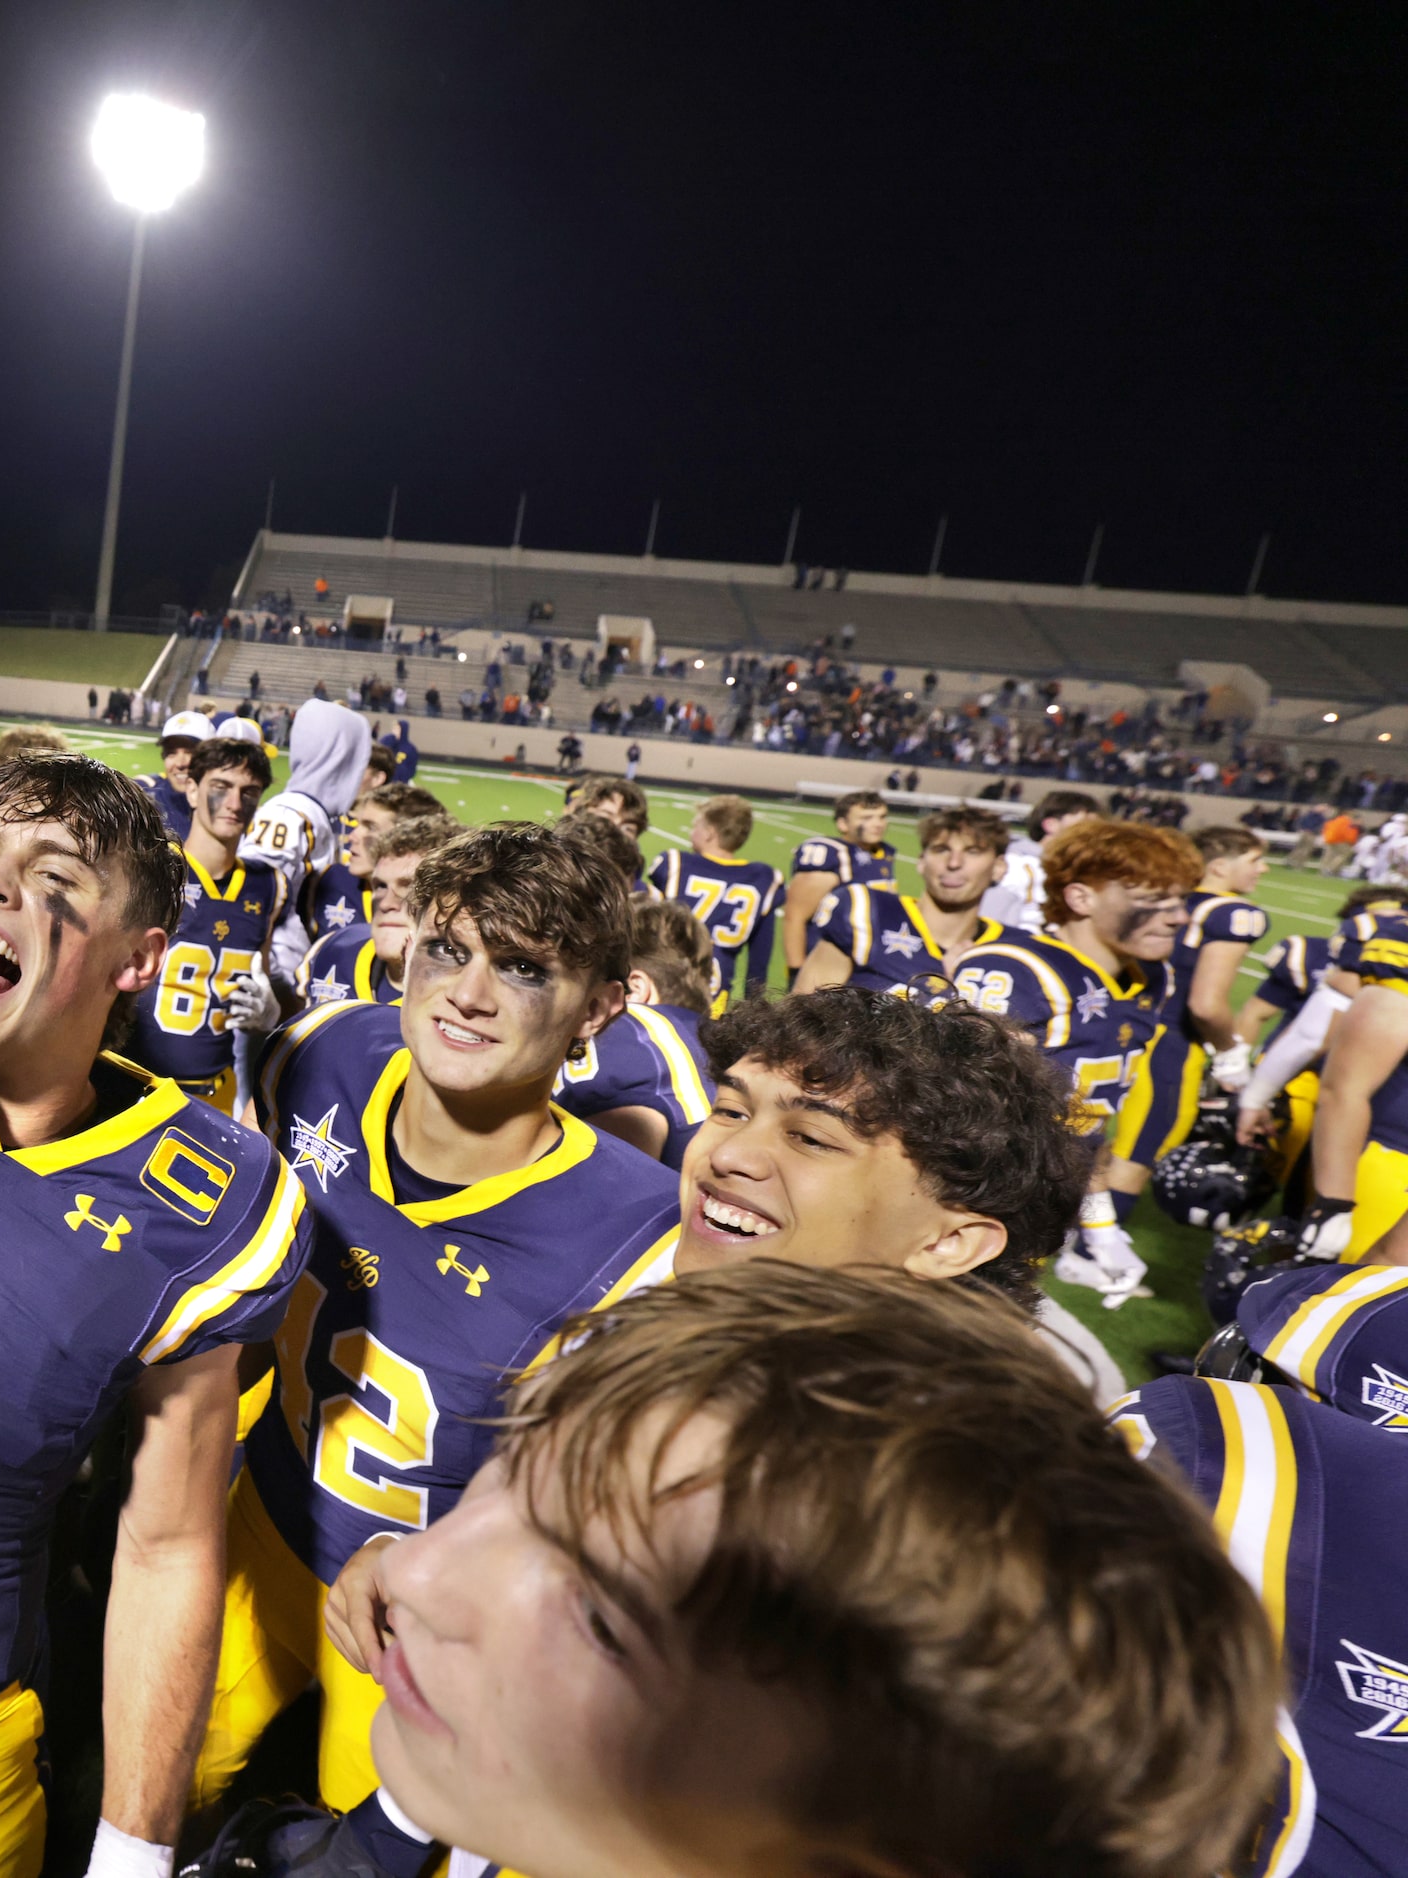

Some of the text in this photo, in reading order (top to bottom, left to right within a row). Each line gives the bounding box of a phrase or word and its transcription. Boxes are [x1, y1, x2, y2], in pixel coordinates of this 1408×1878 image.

[255, 820, 288, 850] 78
[684, 873, 761, 948] 73
[153, 940, 256, 1037] 85
[953, 966, 1014, 1016] 52
[1064, 1048, 1146, 1138] 5
[148, 1137, 229, 1214] C
[341, 1246, 380, 1292] HP
